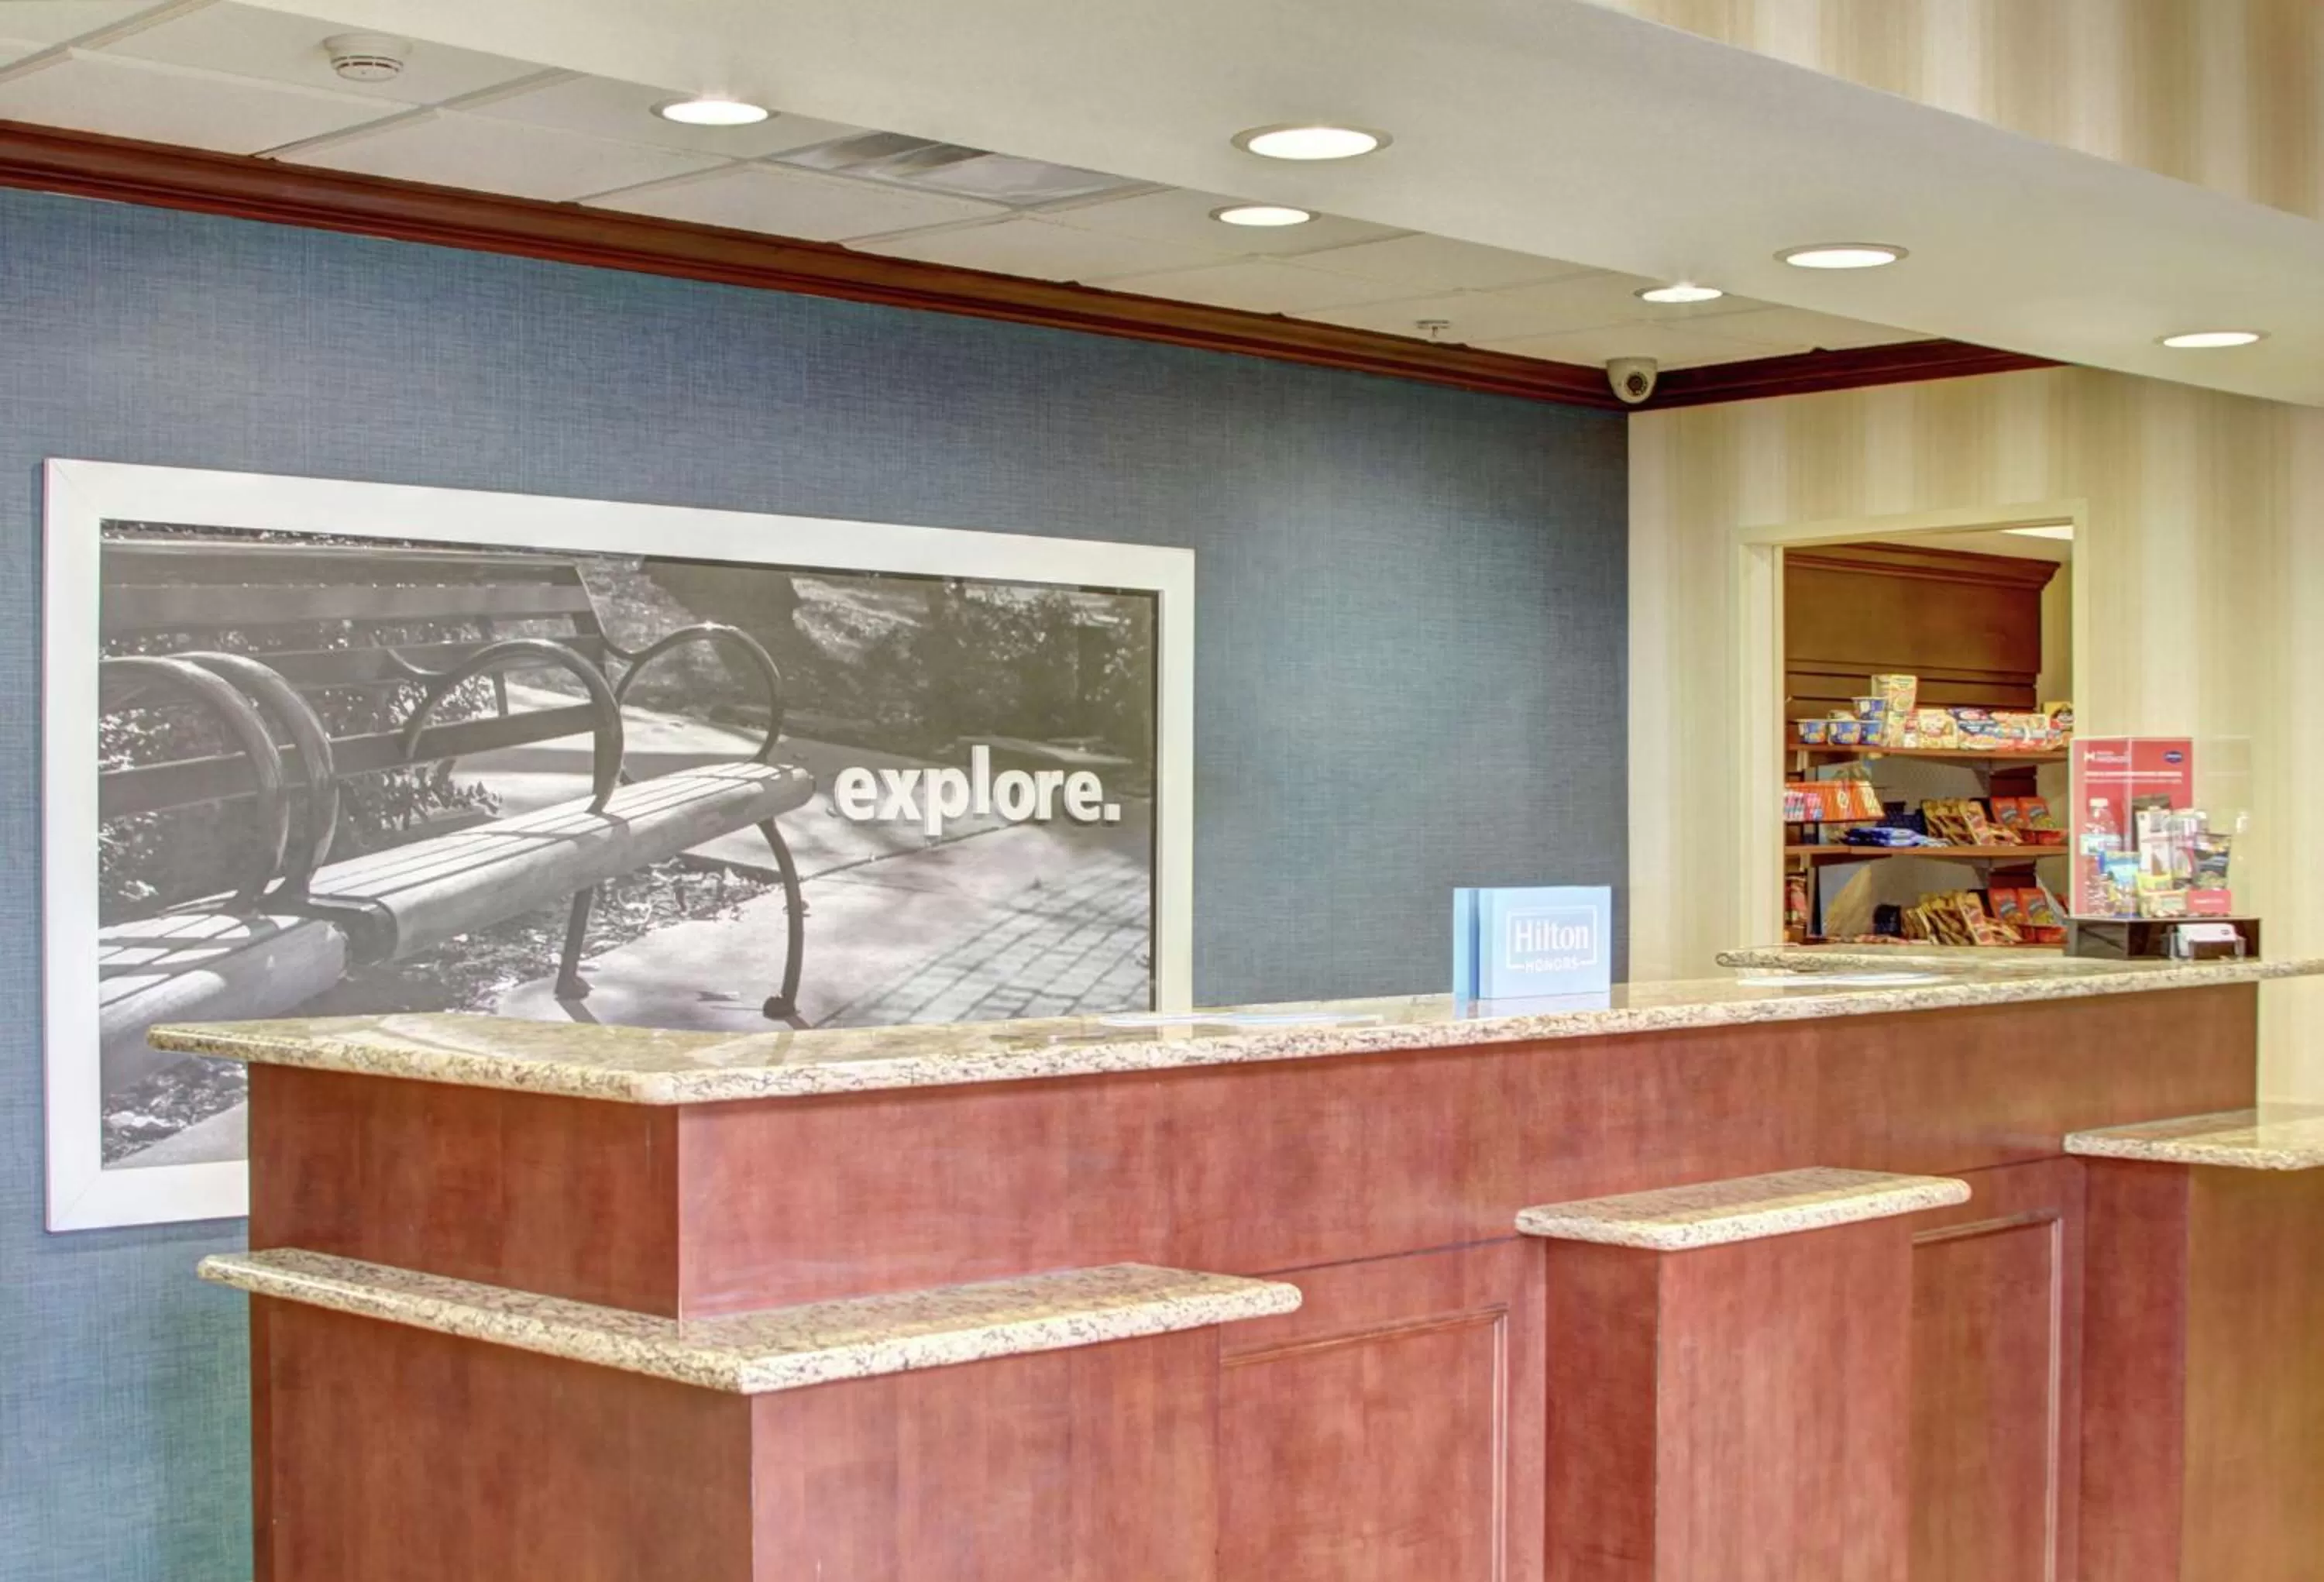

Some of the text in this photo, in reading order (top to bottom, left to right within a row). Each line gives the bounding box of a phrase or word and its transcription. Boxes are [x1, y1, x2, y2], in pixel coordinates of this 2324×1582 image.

[834, 745, 1121, 836] explore.
[1514, 918, 1589, 953] Hilton
[1525, 954, 1580, 974] HONORS
